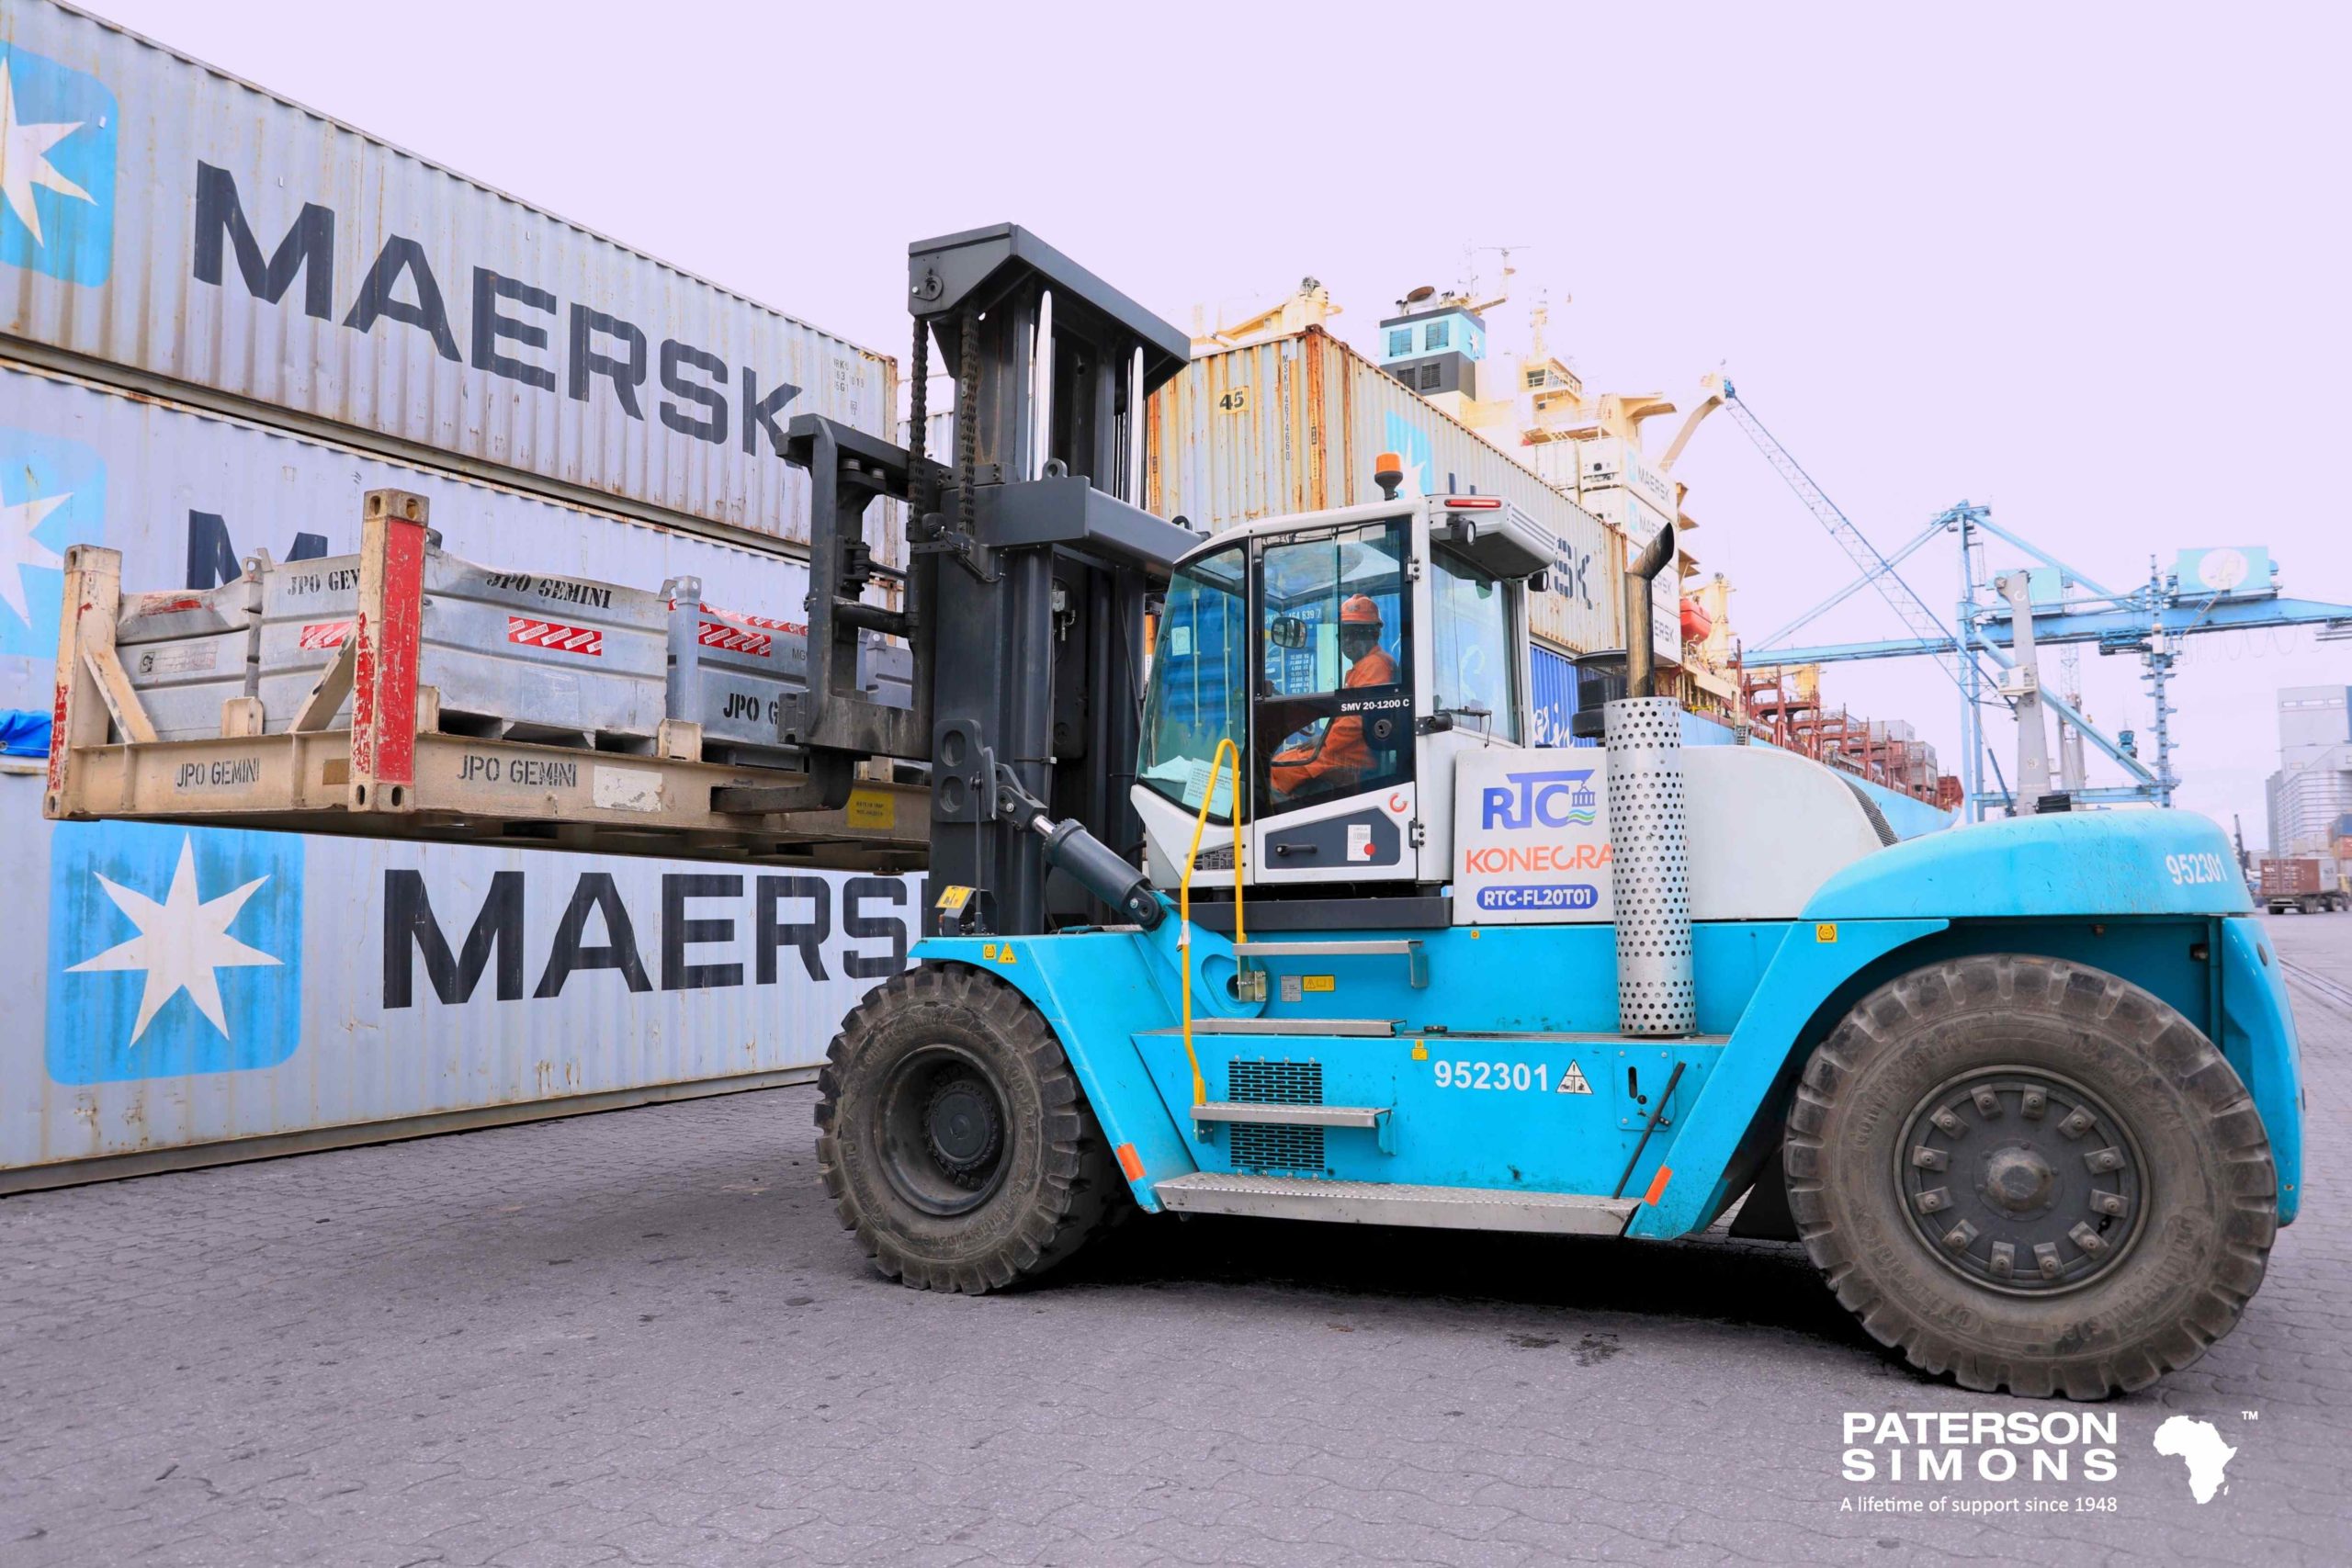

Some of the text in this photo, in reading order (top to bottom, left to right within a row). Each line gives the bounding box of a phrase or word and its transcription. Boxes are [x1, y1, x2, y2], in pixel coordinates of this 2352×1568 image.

[194, 159, 803, 468] MAERSK
[1219, 390, 1245, 411] 45
[1637, 463, 1671, 506] MAERSK
[288, 574, 321, 596] JPO
[486, 571, 613, 609] JPO GEMINI
[723, 693, 760, 722] JPO
[1340, 698, 1410, 712] SMV 20-1200 C
[176, 758, 260, 787] JPO GEMINI
[457, 755, 577, 788] JPO GEMINI
[1483, 769, 1596, 830] RTC
[2165, 852, 2228, 885] 952301
[1483, 888, 1592, 908] RTC-FL20T01
[383, 869, 928, 1009] MAERS
[1433, 1059, 1549, 1092] 952301
